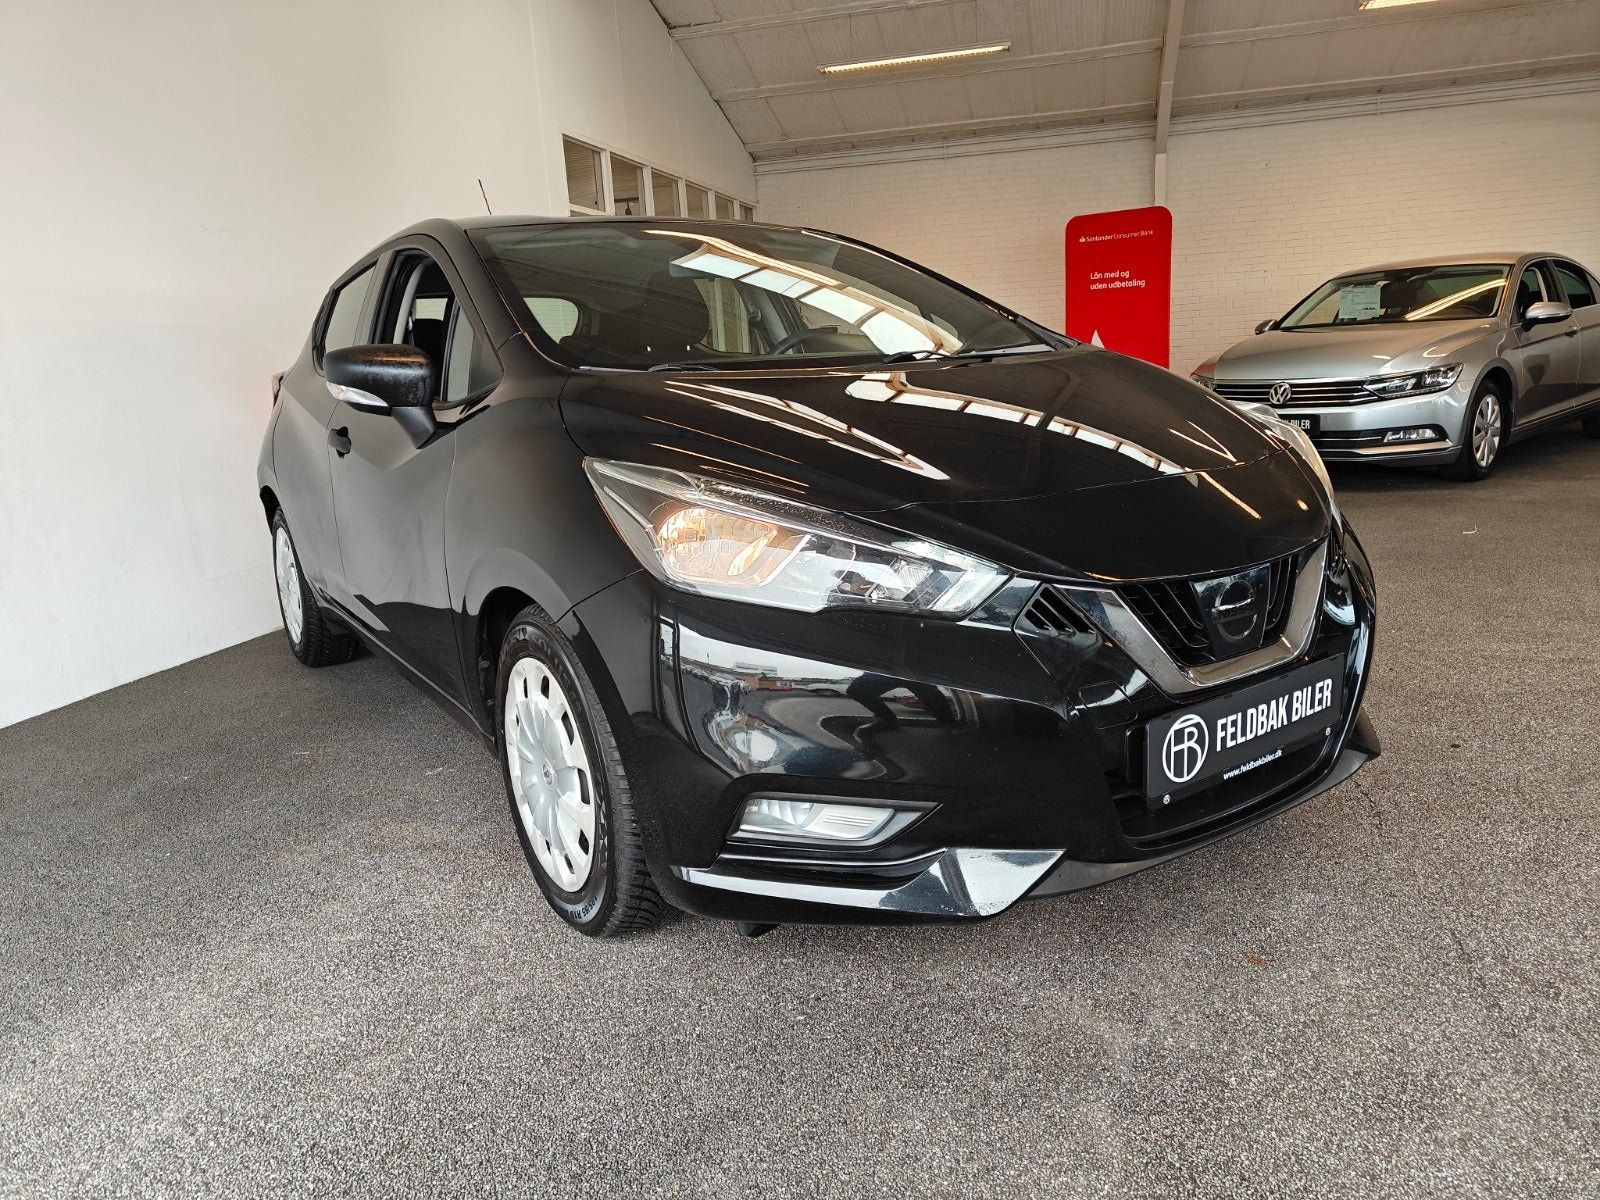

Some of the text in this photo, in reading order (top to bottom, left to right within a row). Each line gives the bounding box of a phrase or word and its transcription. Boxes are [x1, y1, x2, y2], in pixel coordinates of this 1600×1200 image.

[1086, 234, 1113, 242] Santander
[1113, 231, 1140, 239] Consumer
[1090, 269, 1130, 280] Lån med og
[1090, 278, 1146, 290] uden udbetaling
[1216, 678, 1333, 752] FELDBAK BILER
[1223, 749, 1283, 780] www.feldbakbiler.dk
